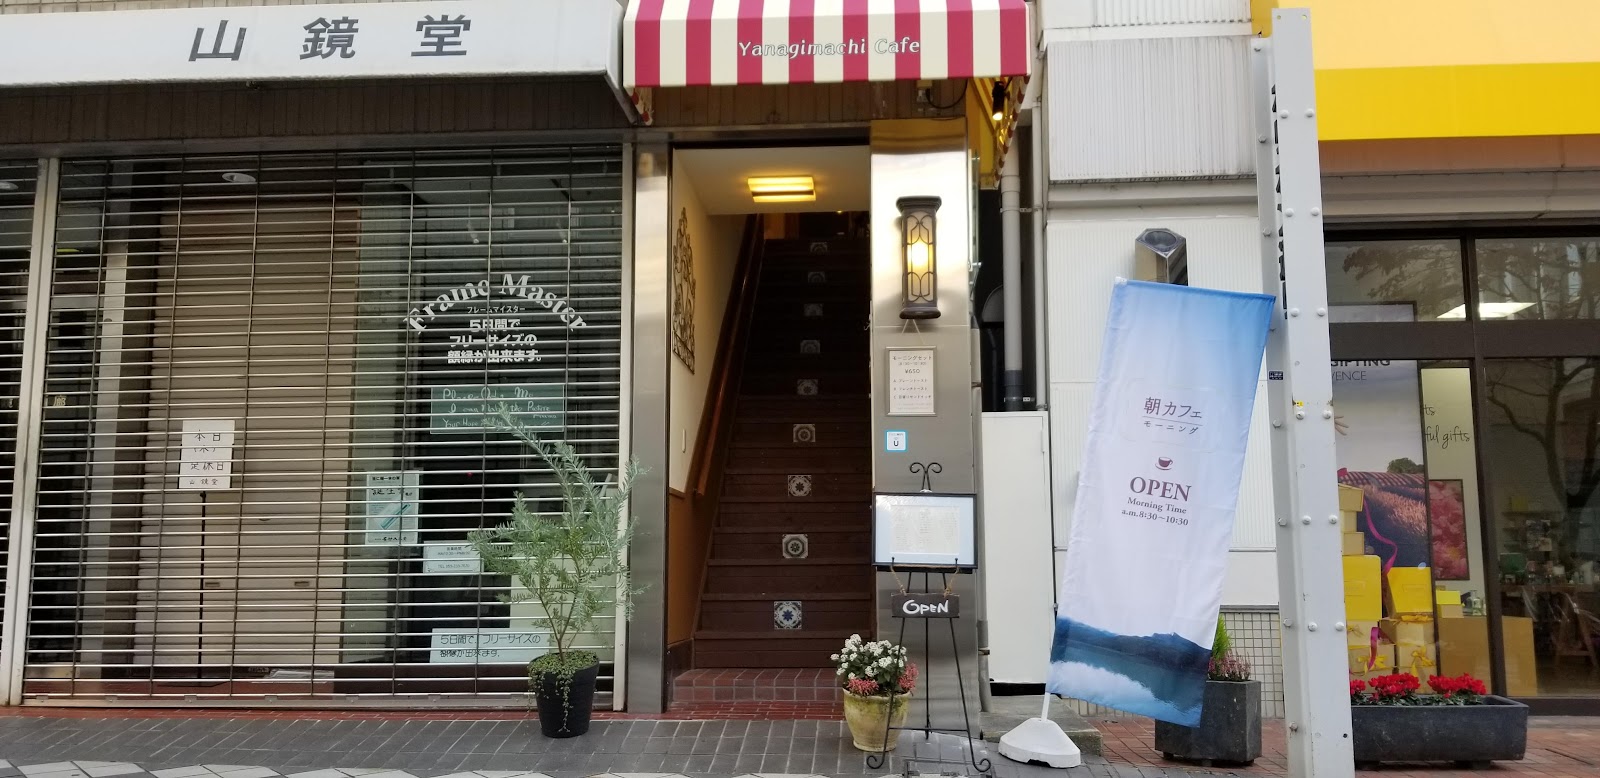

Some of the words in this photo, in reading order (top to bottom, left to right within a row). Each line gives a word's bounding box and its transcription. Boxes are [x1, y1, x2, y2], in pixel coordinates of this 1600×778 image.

[188, 14, 472, 62] 山鏡堂
[738, 39, 867, 59] Yanagimachi
[874, 36, 921, 55] Cafe
[402, 279, 491, 335] Frame
[499, 273, 588, 332] Master
[449, 333, 538, 347] フリーサイズの
[1143, 396, 1203, 419] 朝カフェ
[1144, 420, 1199, 435] モーニング
[1442, 426, 1471, 449] gifts
[1129, 476, 1192, 502] OPEN
[1127, 496, 1164, 512] Morning
[1165, 502, 1187, 515] Time
